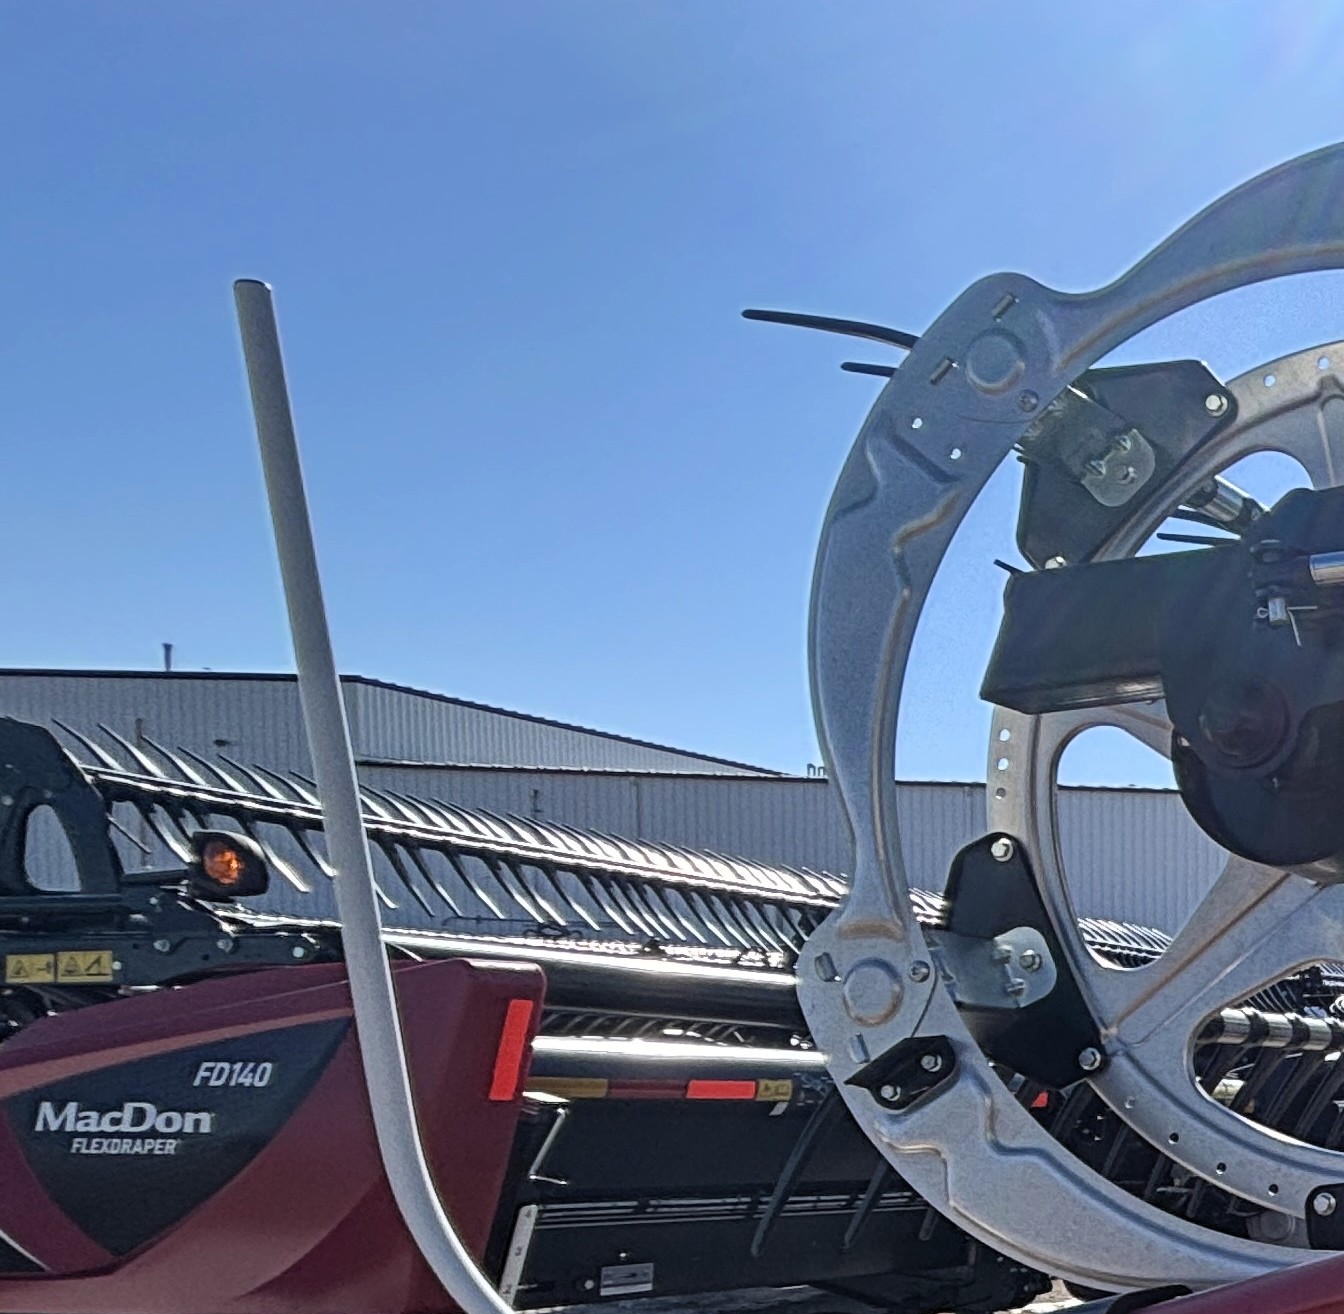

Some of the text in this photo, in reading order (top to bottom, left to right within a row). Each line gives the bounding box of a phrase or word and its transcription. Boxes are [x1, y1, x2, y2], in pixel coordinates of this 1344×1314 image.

[191, 1061, 274, 1088] FD140
[34, 1101, 214, 1134] MacDon
[70, 1137, 178, 1155] FLEXDRAPER
